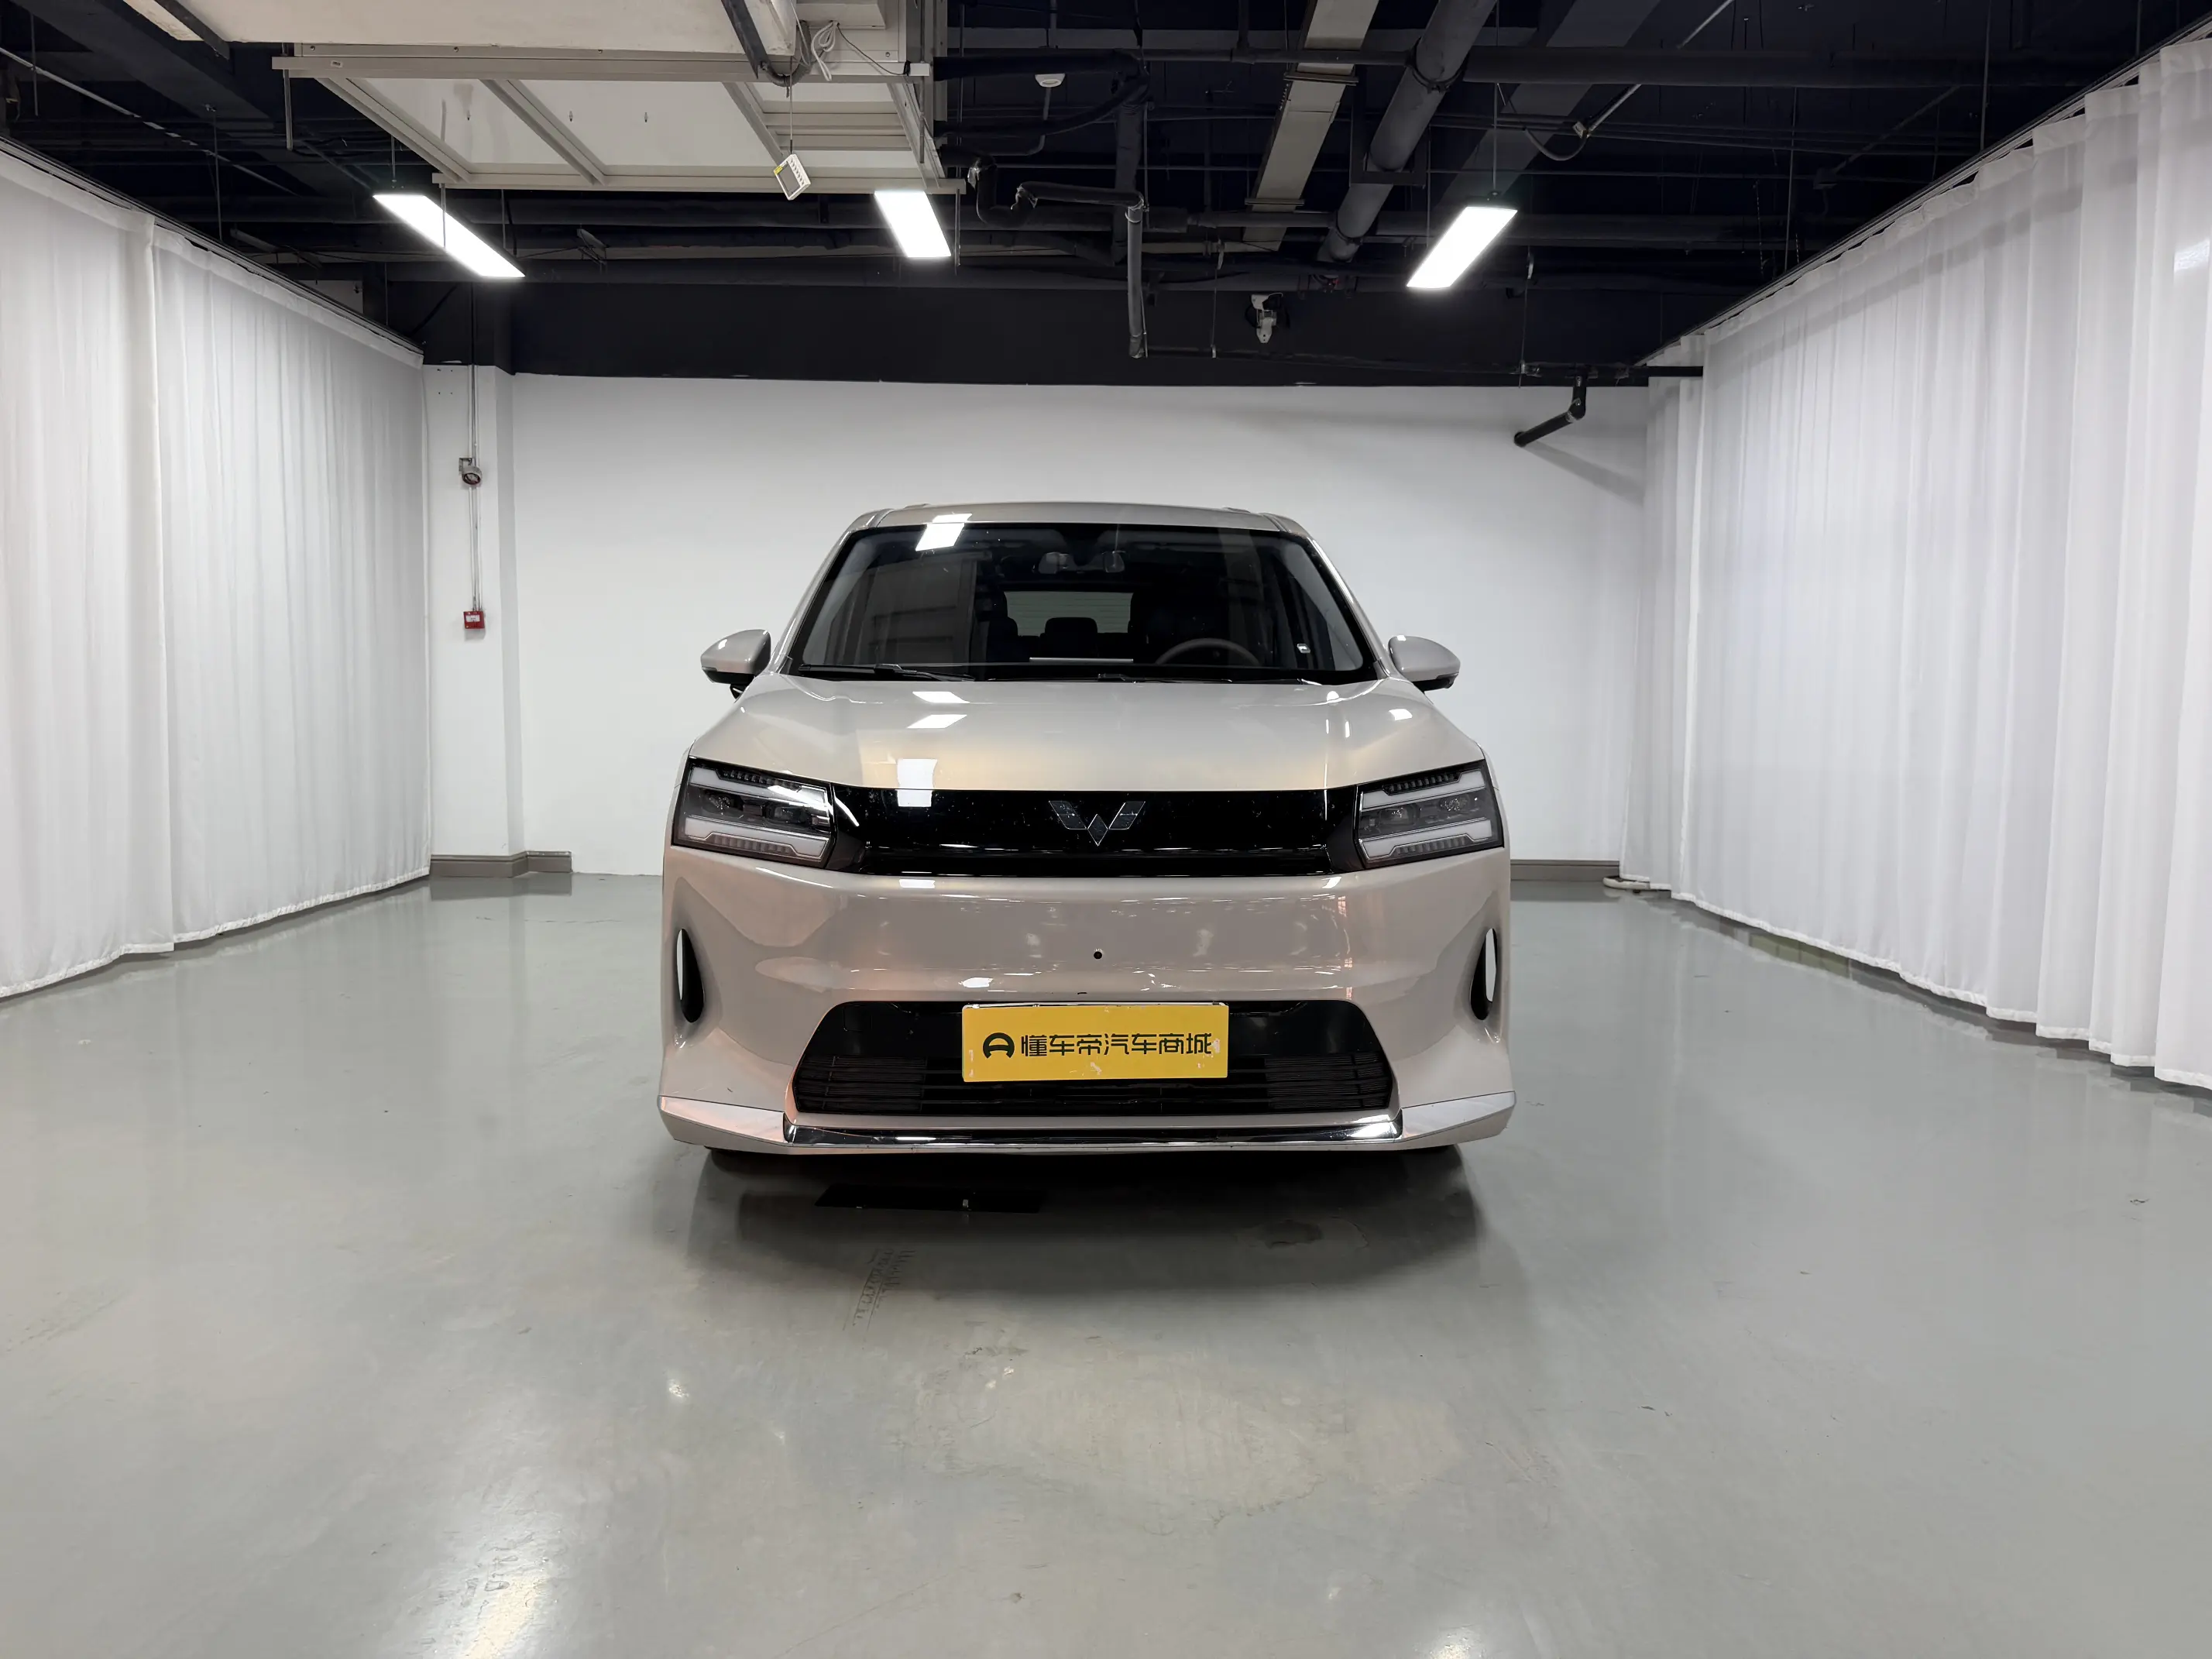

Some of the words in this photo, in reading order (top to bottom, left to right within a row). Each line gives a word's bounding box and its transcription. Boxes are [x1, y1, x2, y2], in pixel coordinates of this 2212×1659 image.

[1021, 1032, 1212, 1057] 懂车帝汽车商城
